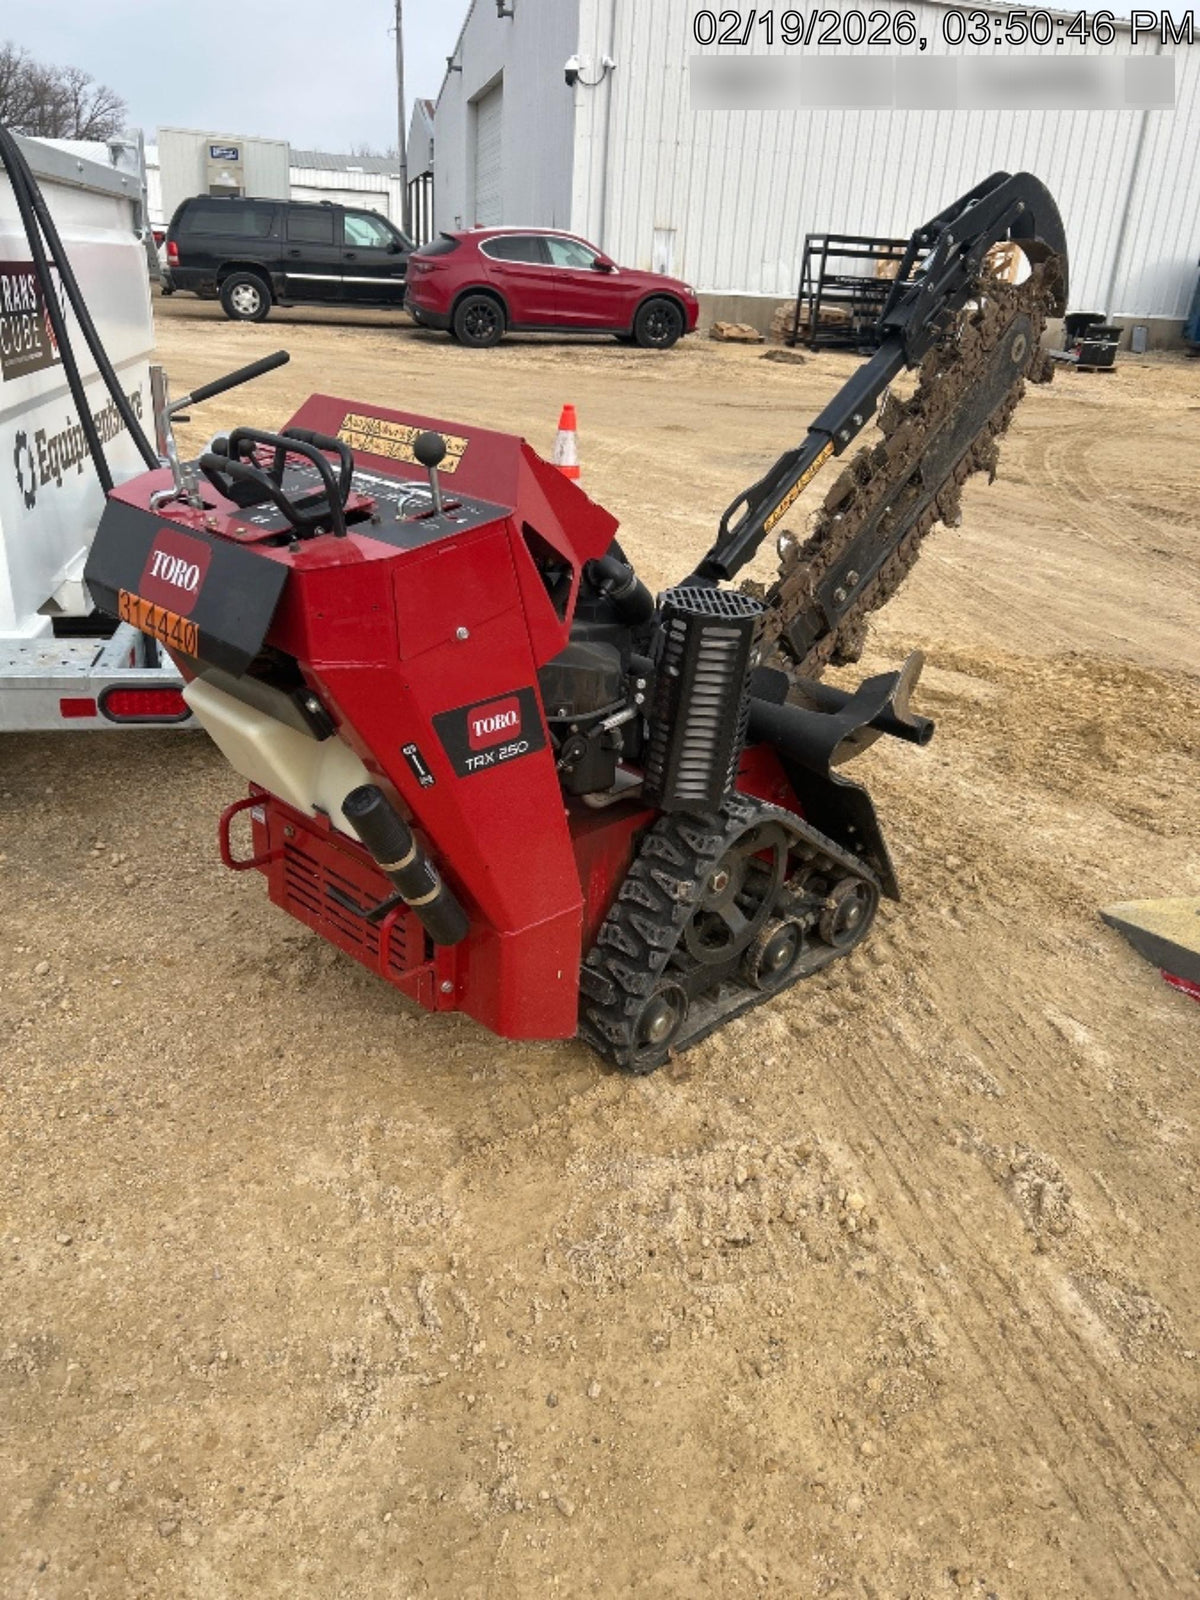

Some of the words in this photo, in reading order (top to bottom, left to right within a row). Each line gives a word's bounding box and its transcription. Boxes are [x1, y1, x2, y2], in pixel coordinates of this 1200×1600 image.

[0, 273, 36, 313] RANS
[0, 313, 42, 355] CUBE
[150, 550, 200, 591] TORO
[120, 591, 198, 655] 314440
[472, 710, 518, 737] TORO
[465, 751, 495, 771] TRX
[499, 740, 529, 760] 250
